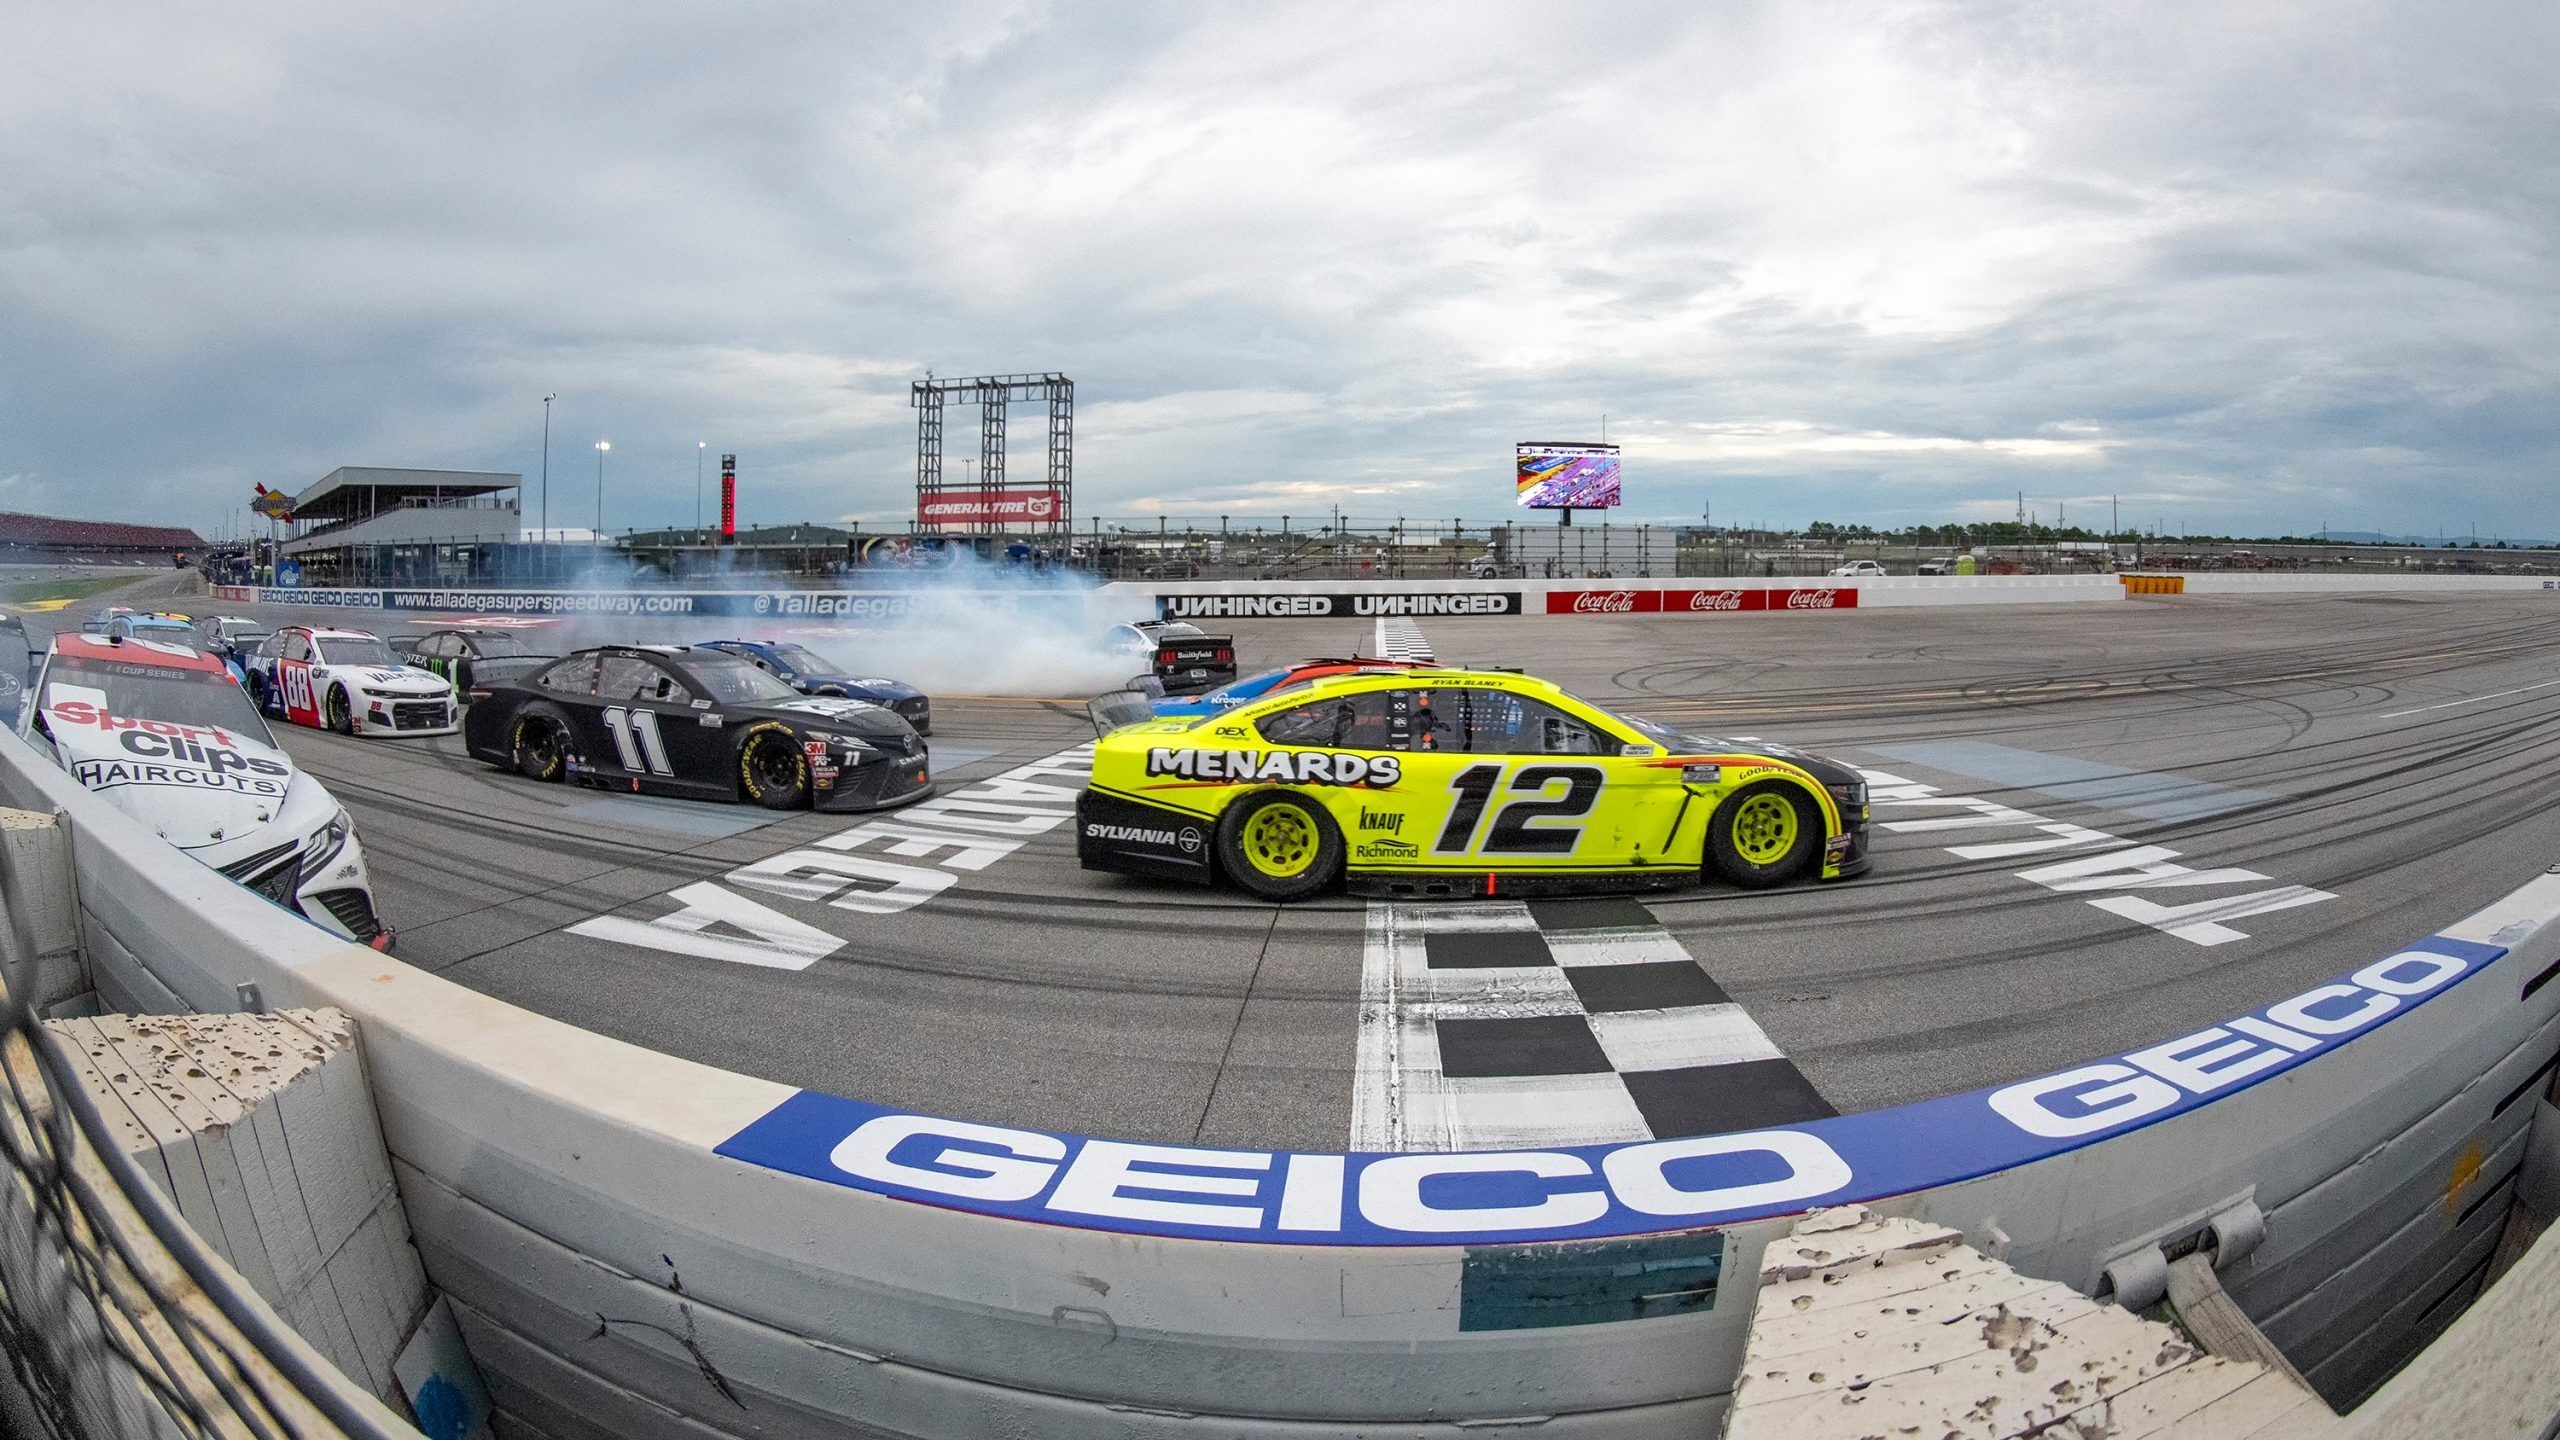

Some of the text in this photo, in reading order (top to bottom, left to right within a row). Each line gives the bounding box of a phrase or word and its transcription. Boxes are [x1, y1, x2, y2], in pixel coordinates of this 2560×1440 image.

[924, 501, 1026, 515] GENERAL TIRE
[262, 589, 283, 603] GEICO
[284, 590, 310, 604] GEICO
[311, 591, 342, 606] GEICO
[344, 592, 380, 607] GEICO
[395, 592, 692, 615] www.talladegasuperspeedway.com
[1354, 595, 1509, 614] UNHINGED
[1169, 596, 1333, 617] UNHINGED
[1177, 651, 1213, 660] Smithfield
[123, 666, 187, 680] CUP SERIES
[286, 665, 313, 712] 88
[1211, 692, 1247, 709] Kroger
[53, 701, 290, 777] Sport Clips
[1215, 727, 1248, 736] DEX
[603, 705, 675, 777] 11
[806, 743, 825, 754] 3M
[843, 751, 860, 766] 11
[1148, 748, 1401, 787] MENARDS
[80, 763, 277, 793] HAIRCUTS
[1429, 761, 1607, 858] 12
[1086, 823, 1176, 845] SYLVANIA
[1356, 844, 1419, 858] Richmond
[1987, 950, 2468, 1138] GEICO
[829, 1113, 1854, 1234] GEICO
